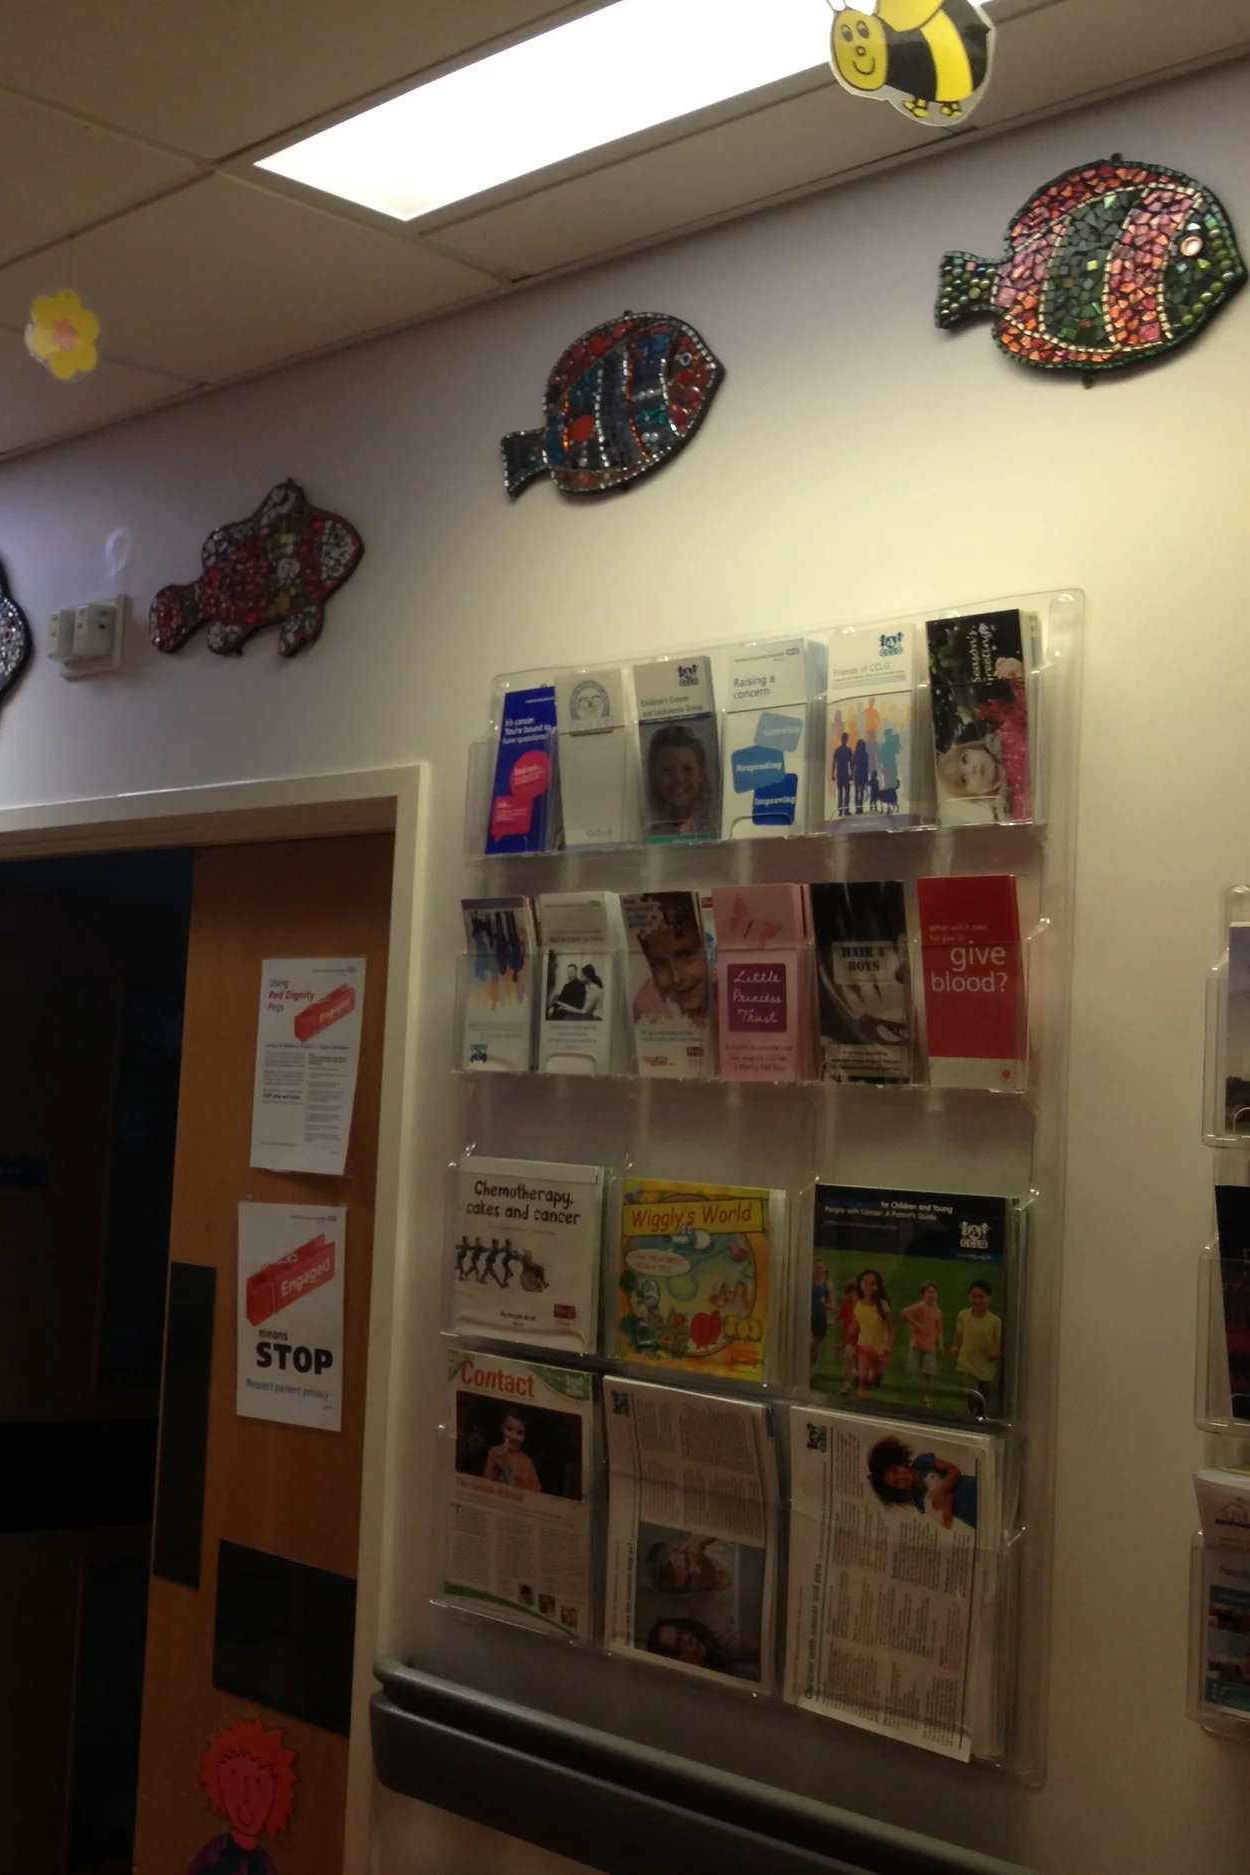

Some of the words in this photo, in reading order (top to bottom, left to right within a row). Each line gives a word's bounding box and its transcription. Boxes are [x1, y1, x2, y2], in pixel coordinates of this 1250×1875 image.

[733, 676, 767, 688] Raising
[769, 675, 776, 684] a
[733, 688, 771, 700] concern
[735, 761, 783, 773] Responding
[754, 796, 796, 807] Improving
[842, 946, 874, 959] HAIR
[950, 940, 1007, 973] give
[848, 960, 881, 972] BOYS
[733, 970, 781, 984] Little
[930, 970, 1009, 994] blood?
[268, 990, 284, 1000] Red
[285, 990, 315, 1003] Dignity
[733, 987, 783, 1004] Princess
[267, 1002, 285, 1014] Pegs
[736, 1008, 778, 1024] Trust
[474, 1180, 574, 1210] Chemotherapy,
[466, 1200, 501, 1218] cakes
[504, 1203, 530, 1221] and
[533, 1209, 582, 1225] cancer
[824, 1206, 846, 1215] People
[890, 1200, 917, 1212] Children
[931, 1204, 953, 1215] Young
[631, 1207, 696, 1233] Wiggly's
[701, 1202, 753, 1225] World
[280, 1256, 331, 1298] Engaged
[258, 1329, 289, 1341] means
[256, 1341, 334, 1376] STOP
[460, 1359, 535, 1399] Contact
[245, 1378, 274, 1392] Respect
[274, 1383, 303, 1396] patient
[302, 1388, 330, 1402] privacy
